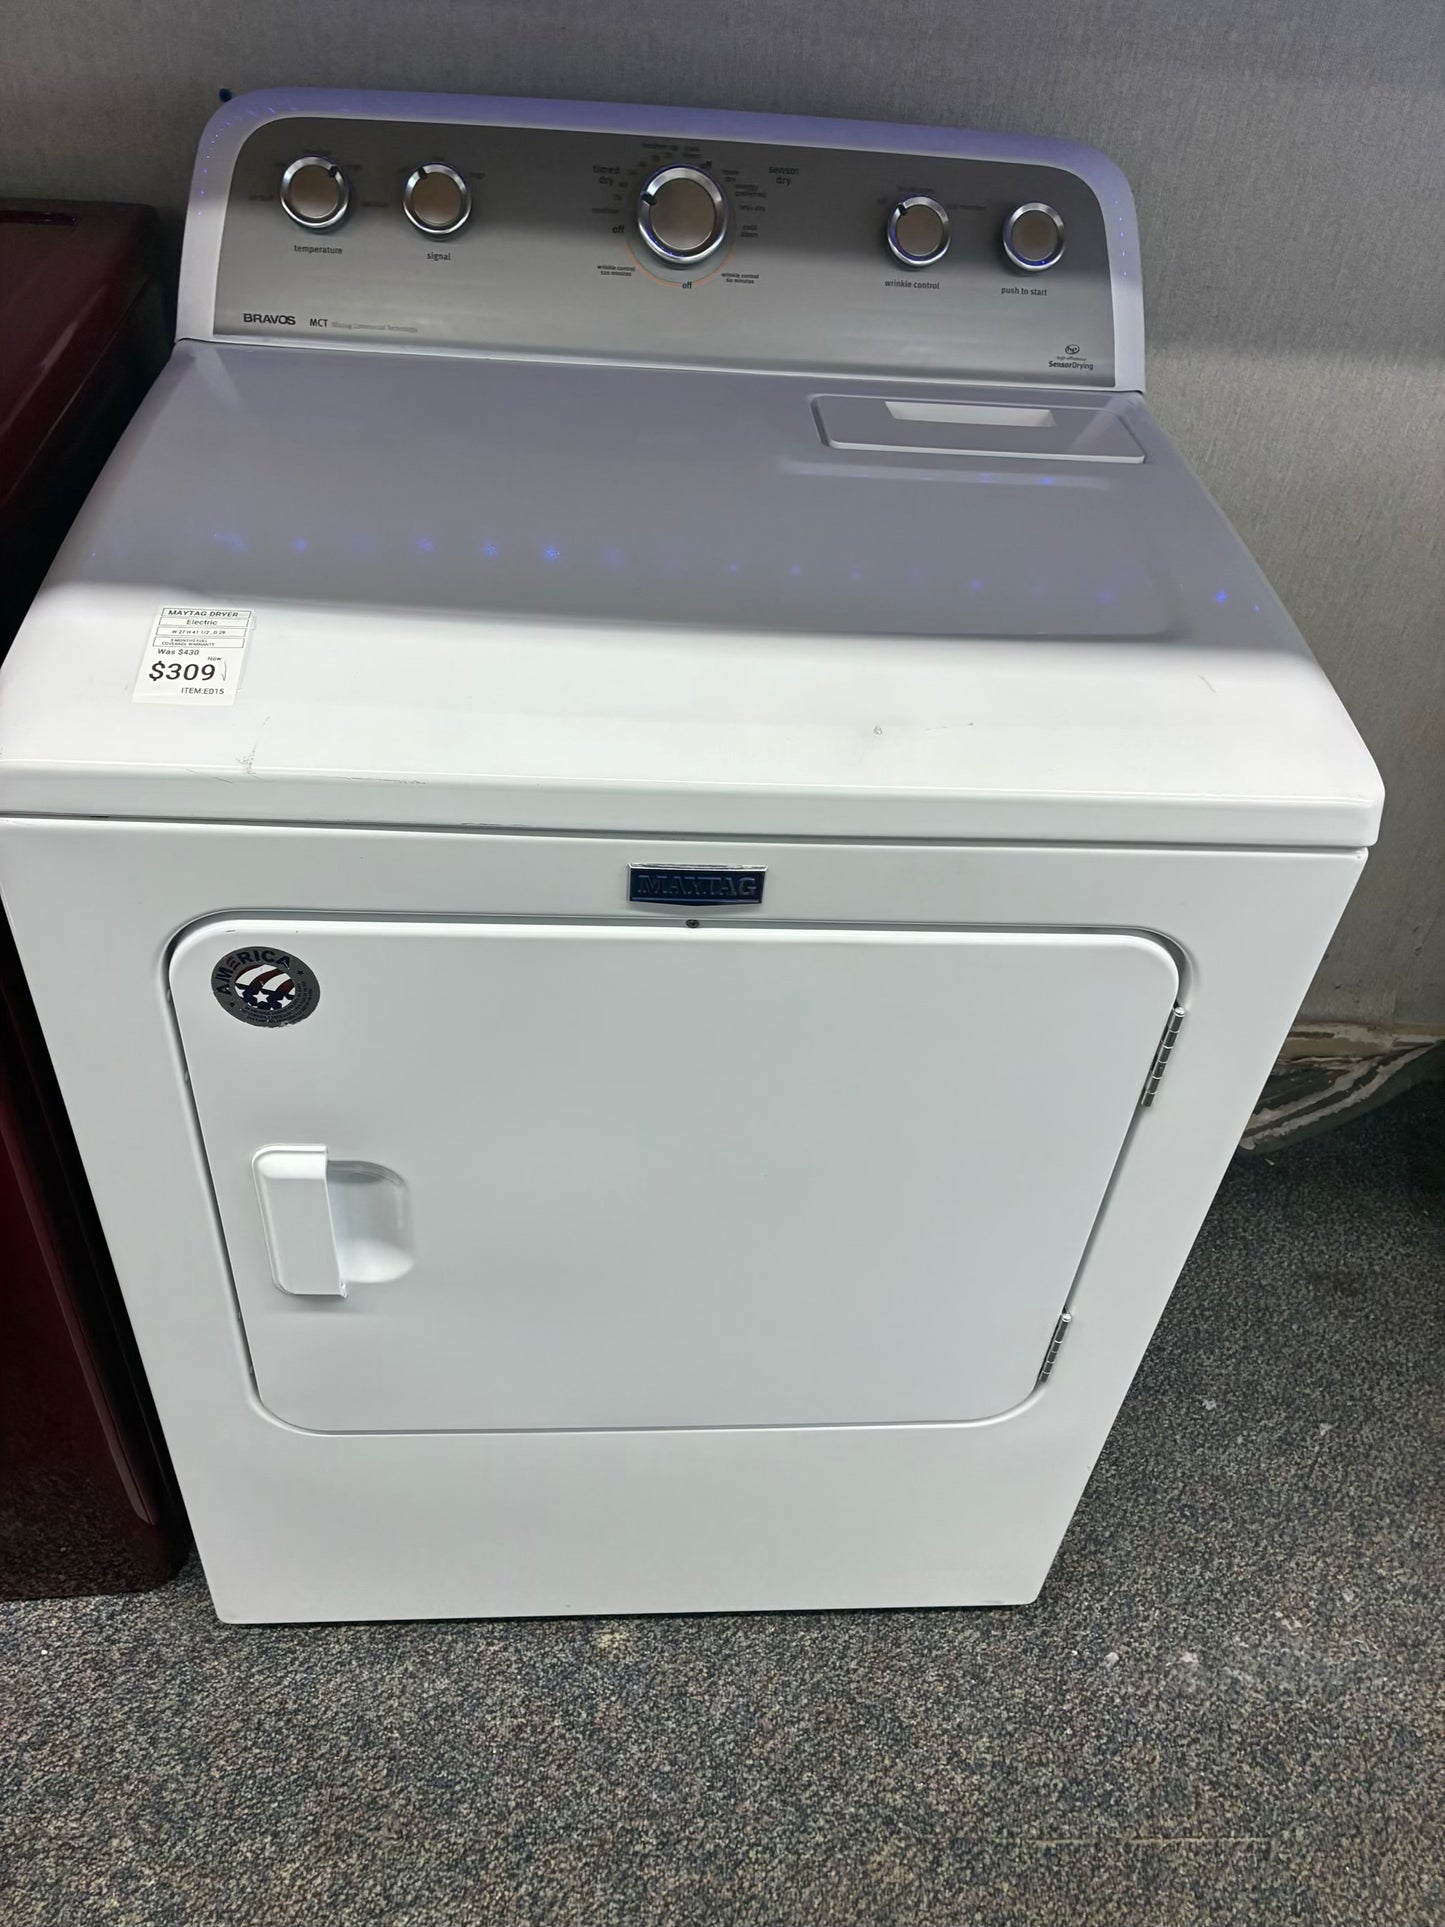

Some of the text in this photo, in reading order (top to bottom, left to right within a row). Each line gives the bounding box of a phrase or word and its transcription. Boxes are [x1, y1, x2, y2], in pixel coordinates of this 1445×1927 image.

[592, 164, 621, 175] timed
[768, 165, 800, 175] sensor
[599, 175, 614, 187] dry
[776, 176, 791, 187] dry
[612, 225, 625, 234] off
[294, 244, 343, 255] temperature
[427, 252, 451, 262] signal
[682, 281, 692, 289] off
[885, 279, 940, 290] wrinkle control
[1001, 286, 1048, 297] push to start
[243, 313, 296, 326] BRAVOS
[310, 318, 328, 328] MCT
[1048, 360, 1094, 371] SensorDrying
[178, 648, 200, 656] $430
[149, 660, 216, 681] $309
[181, 687, 225, 695] ITEM:ED15
[637, 874, 757, 896] MAYTAG
[215, 950, 291, 996] AMERICA
